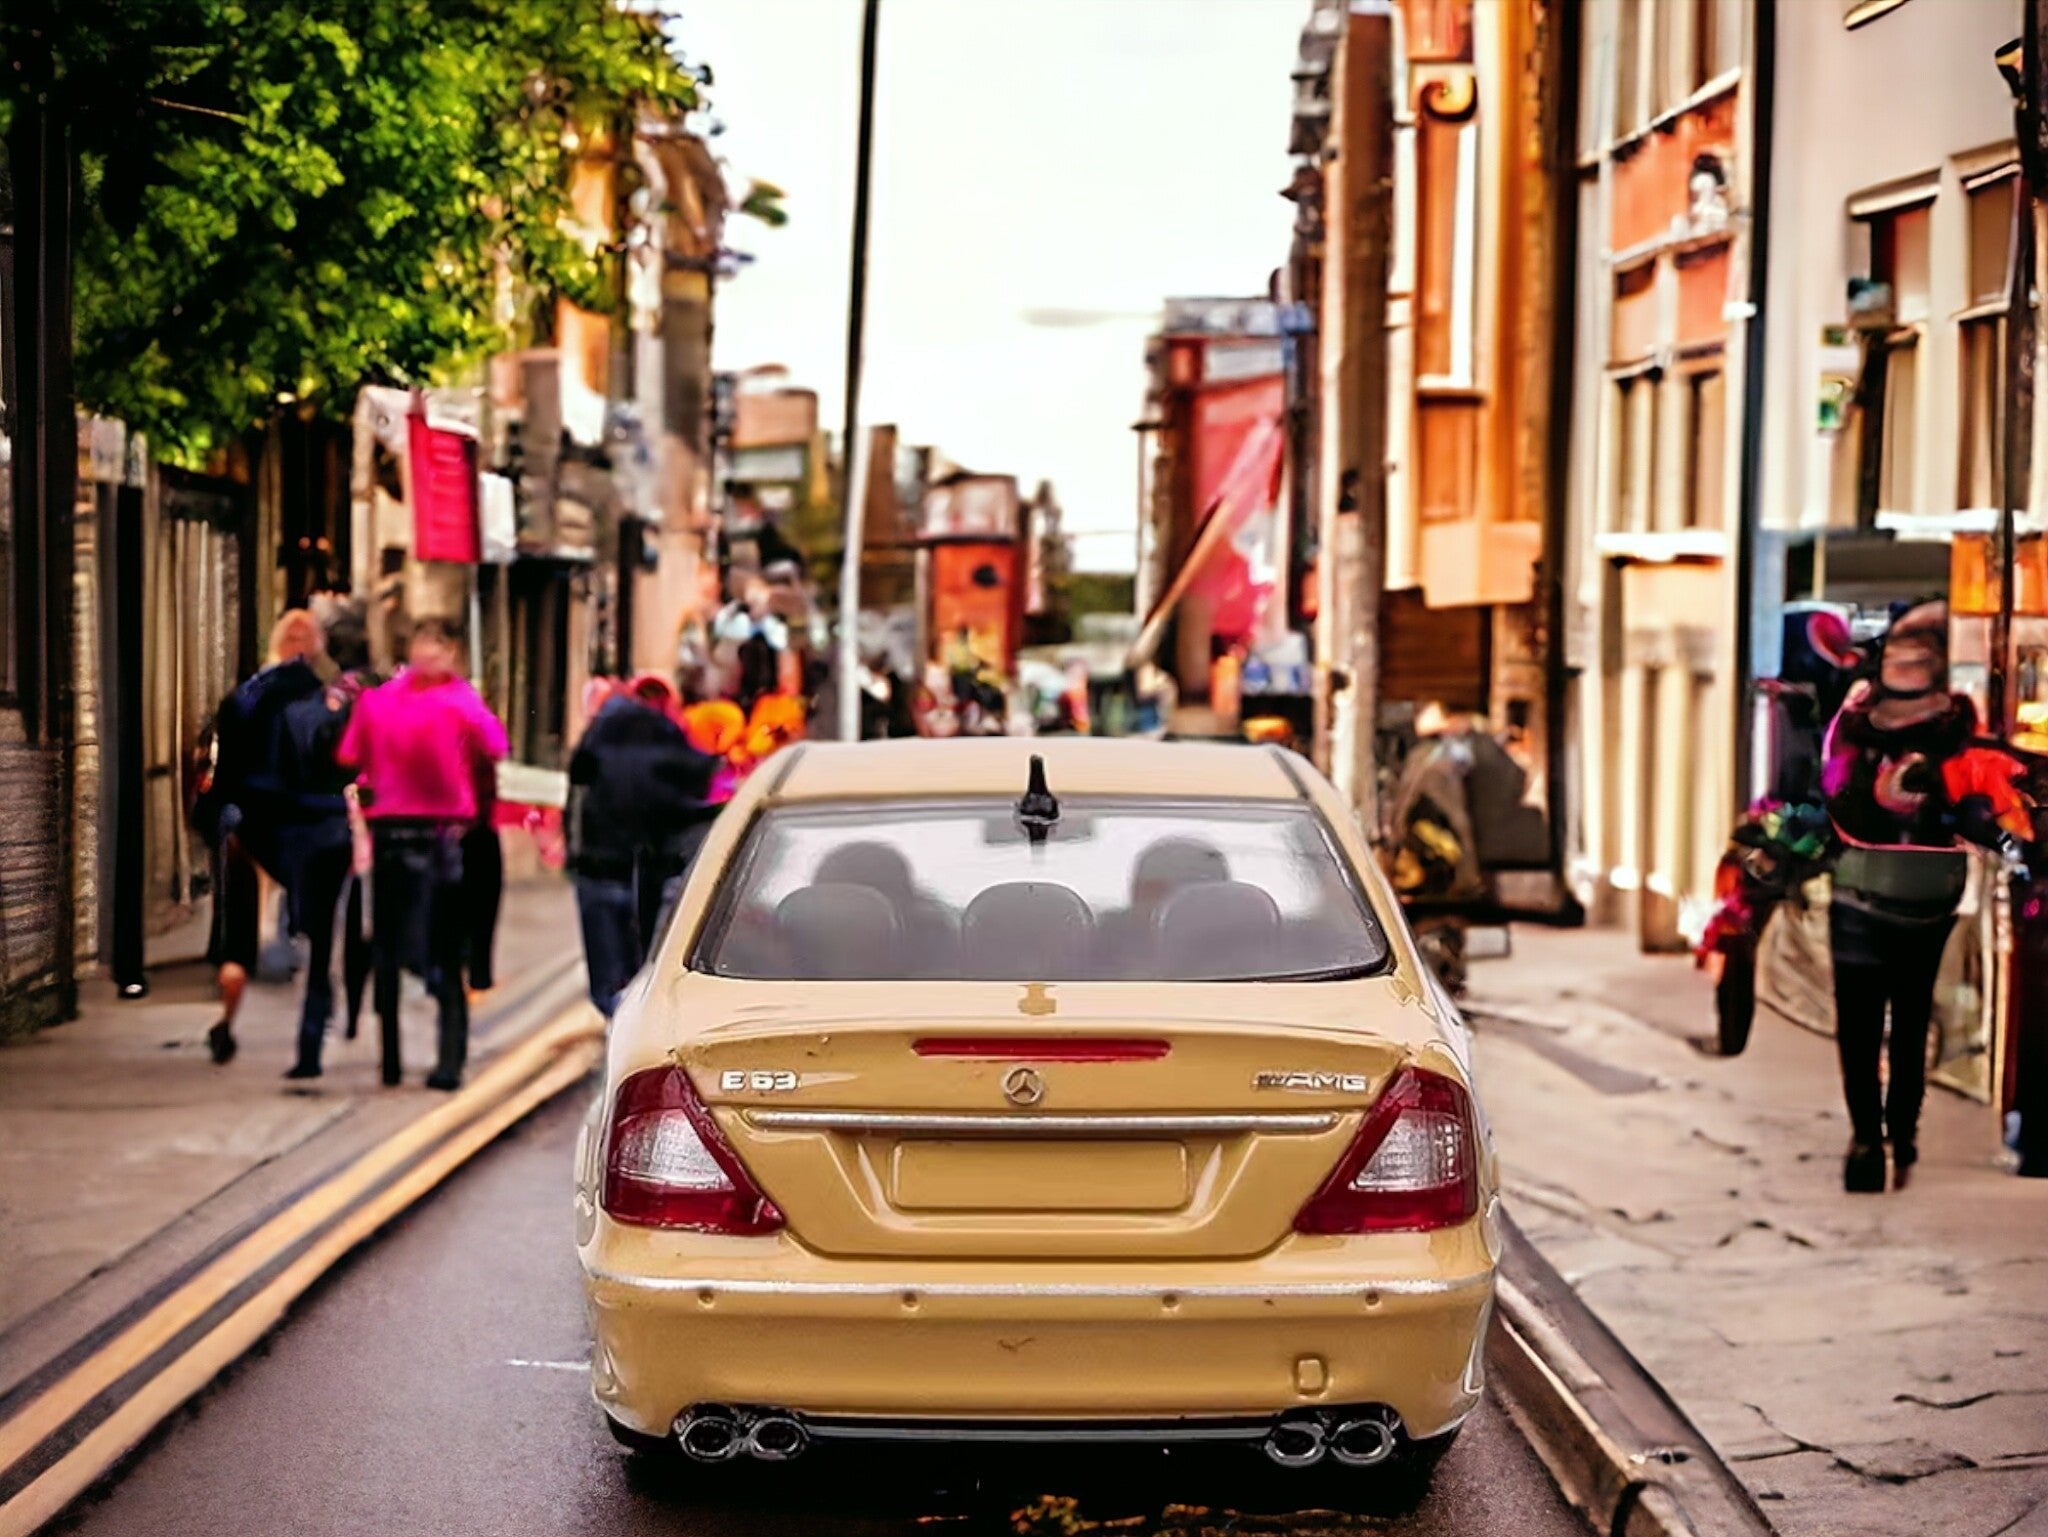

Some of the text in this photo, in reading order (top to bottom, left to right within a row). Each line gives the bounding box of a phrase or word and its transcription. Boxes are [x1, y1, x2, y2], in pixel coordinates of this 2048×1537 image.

[721, 1071, 797, 1090] E 63
[1286, 1072, 1366, 1091] AMG
